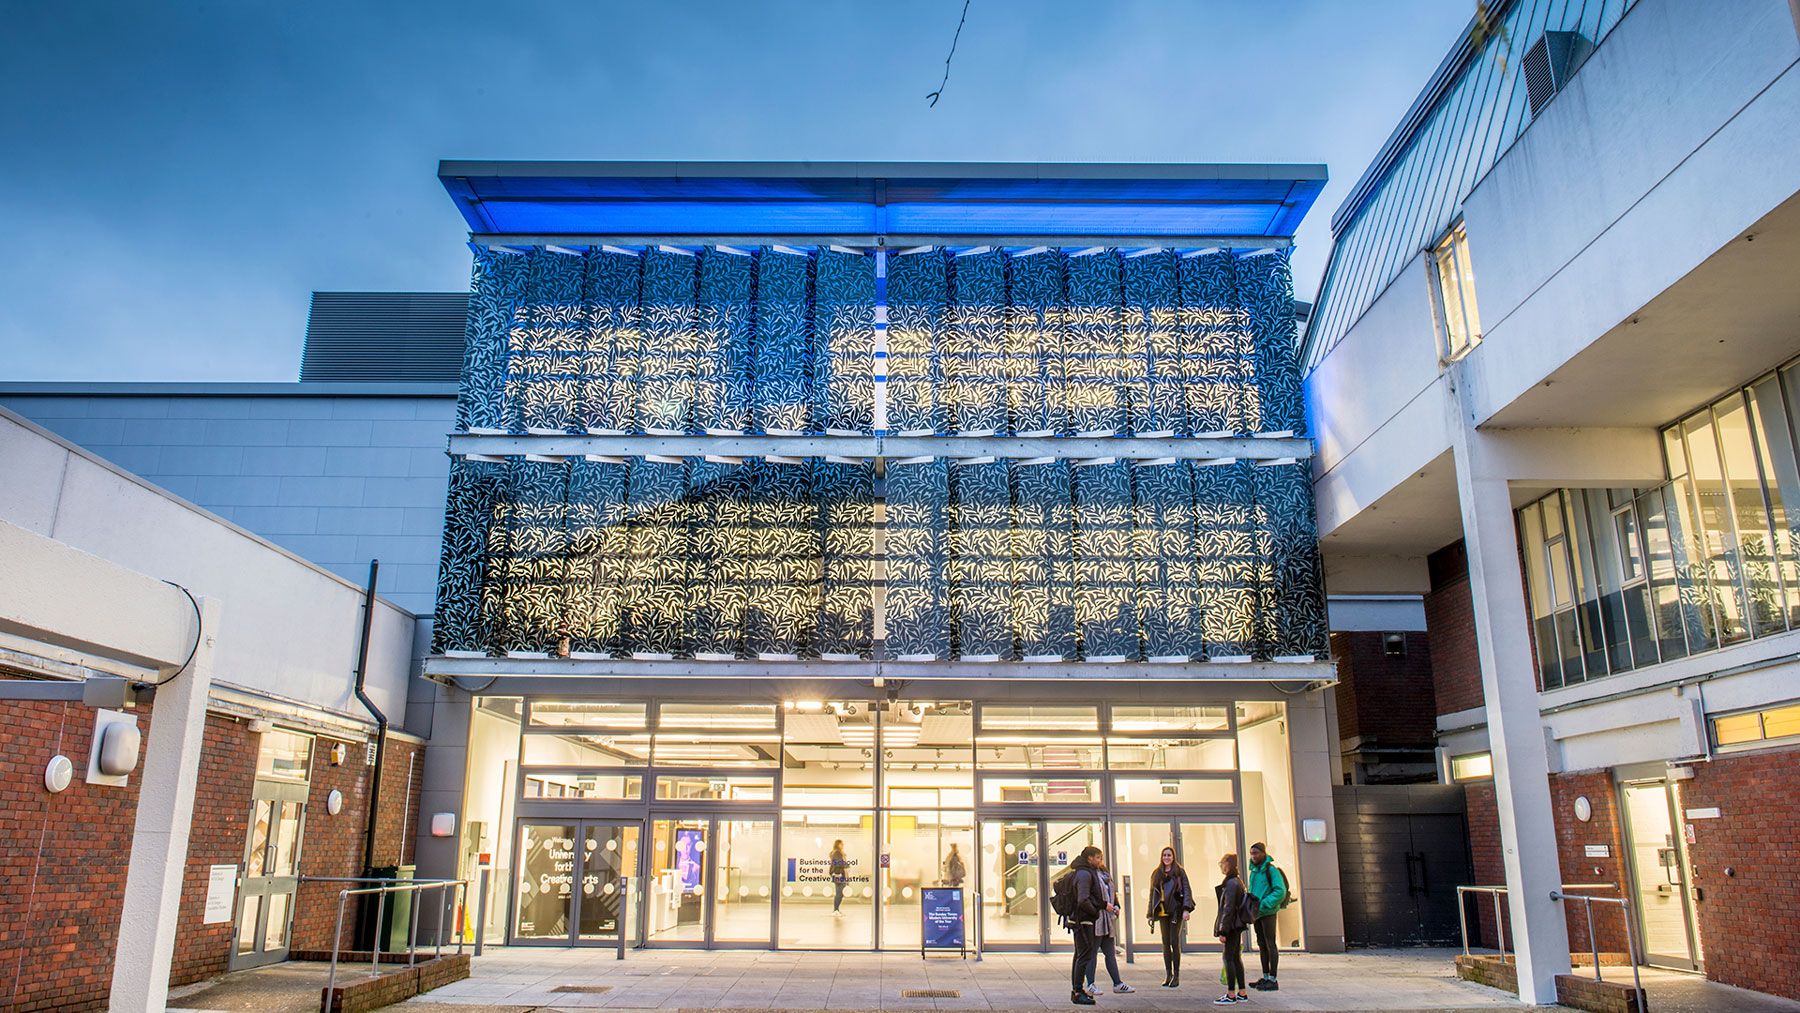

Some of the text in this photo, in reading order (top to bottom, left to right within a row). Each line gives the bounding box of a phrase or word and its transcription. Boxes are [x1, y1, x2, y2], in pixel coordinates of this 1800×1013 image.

[555, 861, 574, 871] for th
[799, 858, 858, 866] Business School
[541, 873, 598, 884] Creative rts
